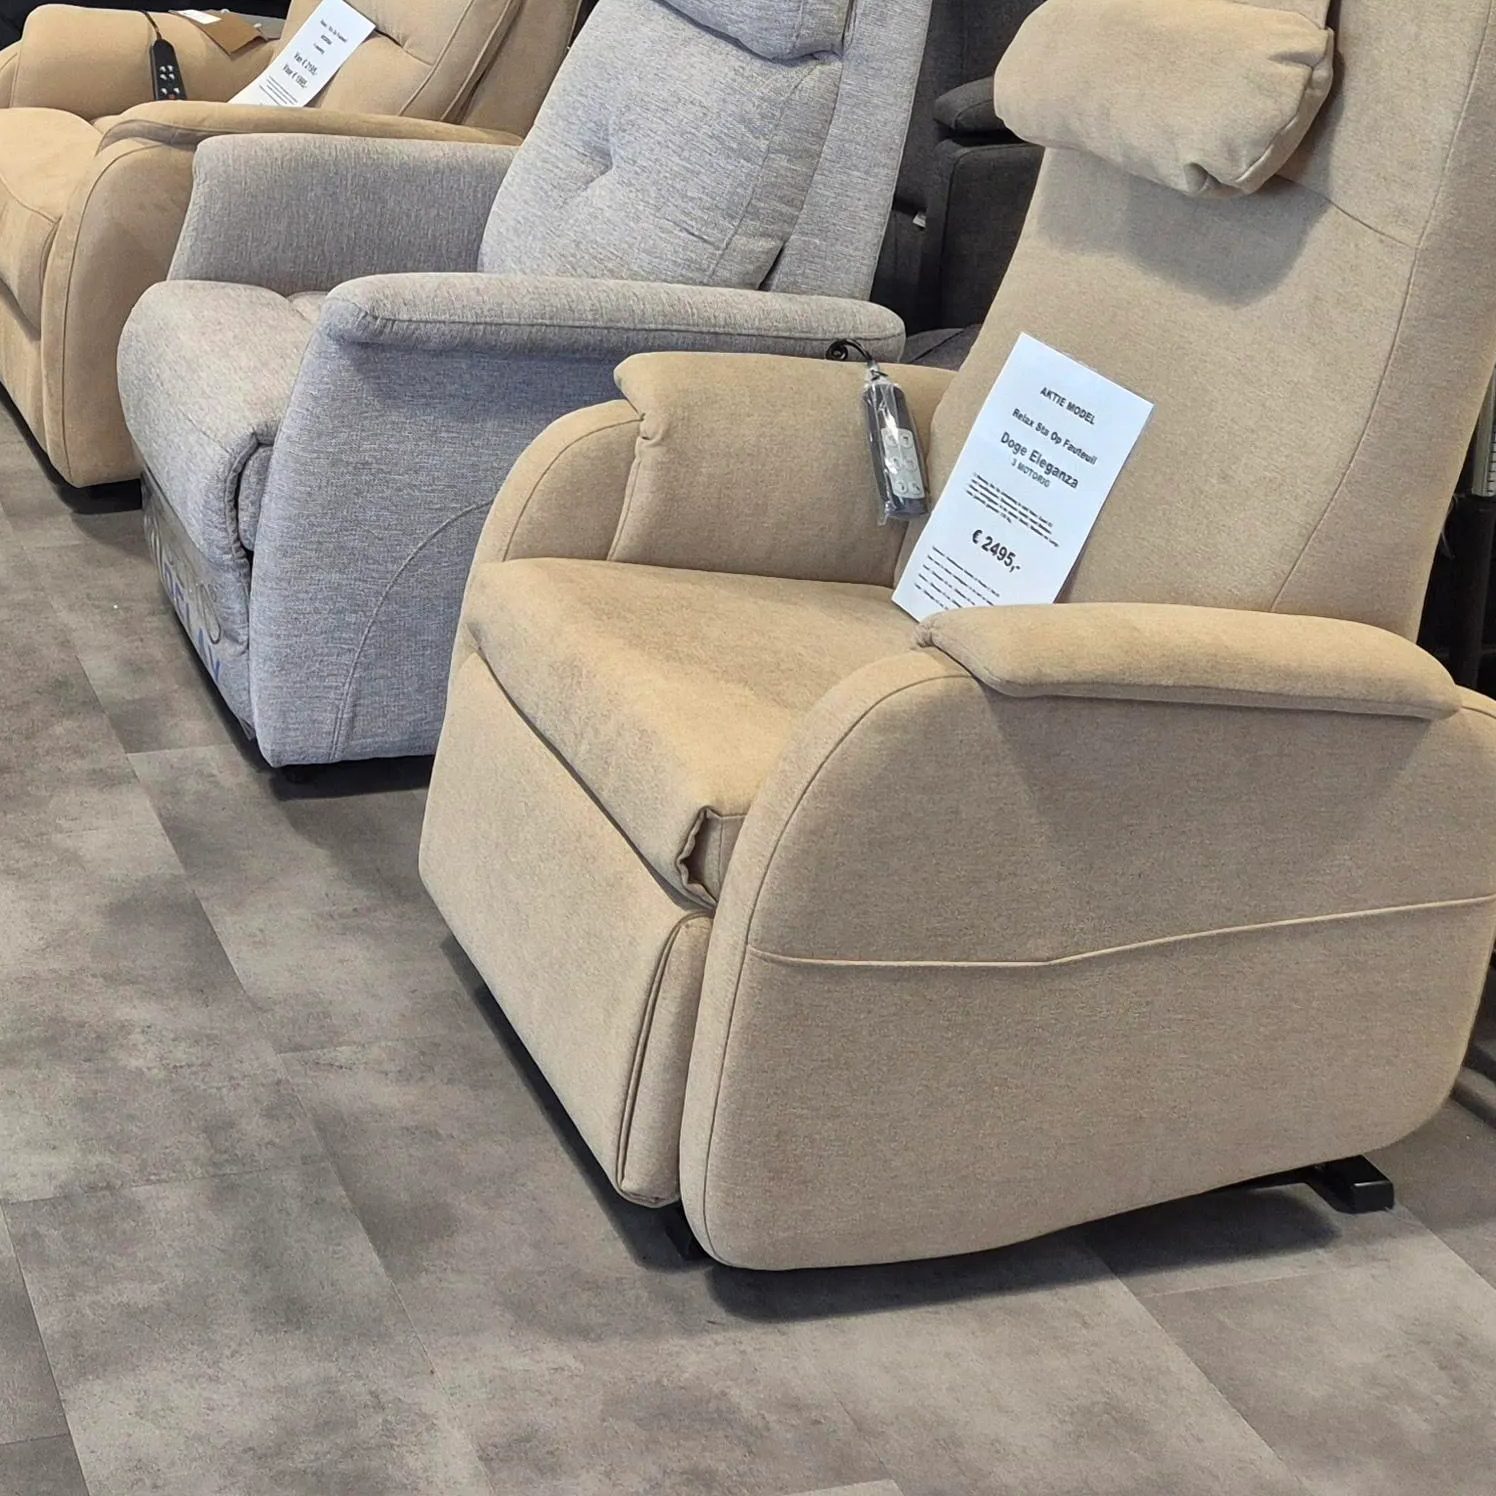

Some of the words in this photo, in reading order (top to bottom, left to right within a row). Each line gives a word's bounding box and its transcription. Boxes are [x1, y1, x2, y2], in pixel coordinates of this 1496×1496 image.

[1040, 387, 1066, 407] AKTIE
[1066, 401, 1096, 425] MODEL
[1000, 431, 1028, 456] Doge
[1028, 449, 1079, 488] Eleganza
[1012, 408, 1034, 428] Relax
[1035, 422, 1049, 436] Sta
[1050, 431, 1062, 445] Op
[1063, 438, 1098, 465] Fauteuil
[972, 529, 983, 544] €
[981, 536, 1021, 573] 2495,-
